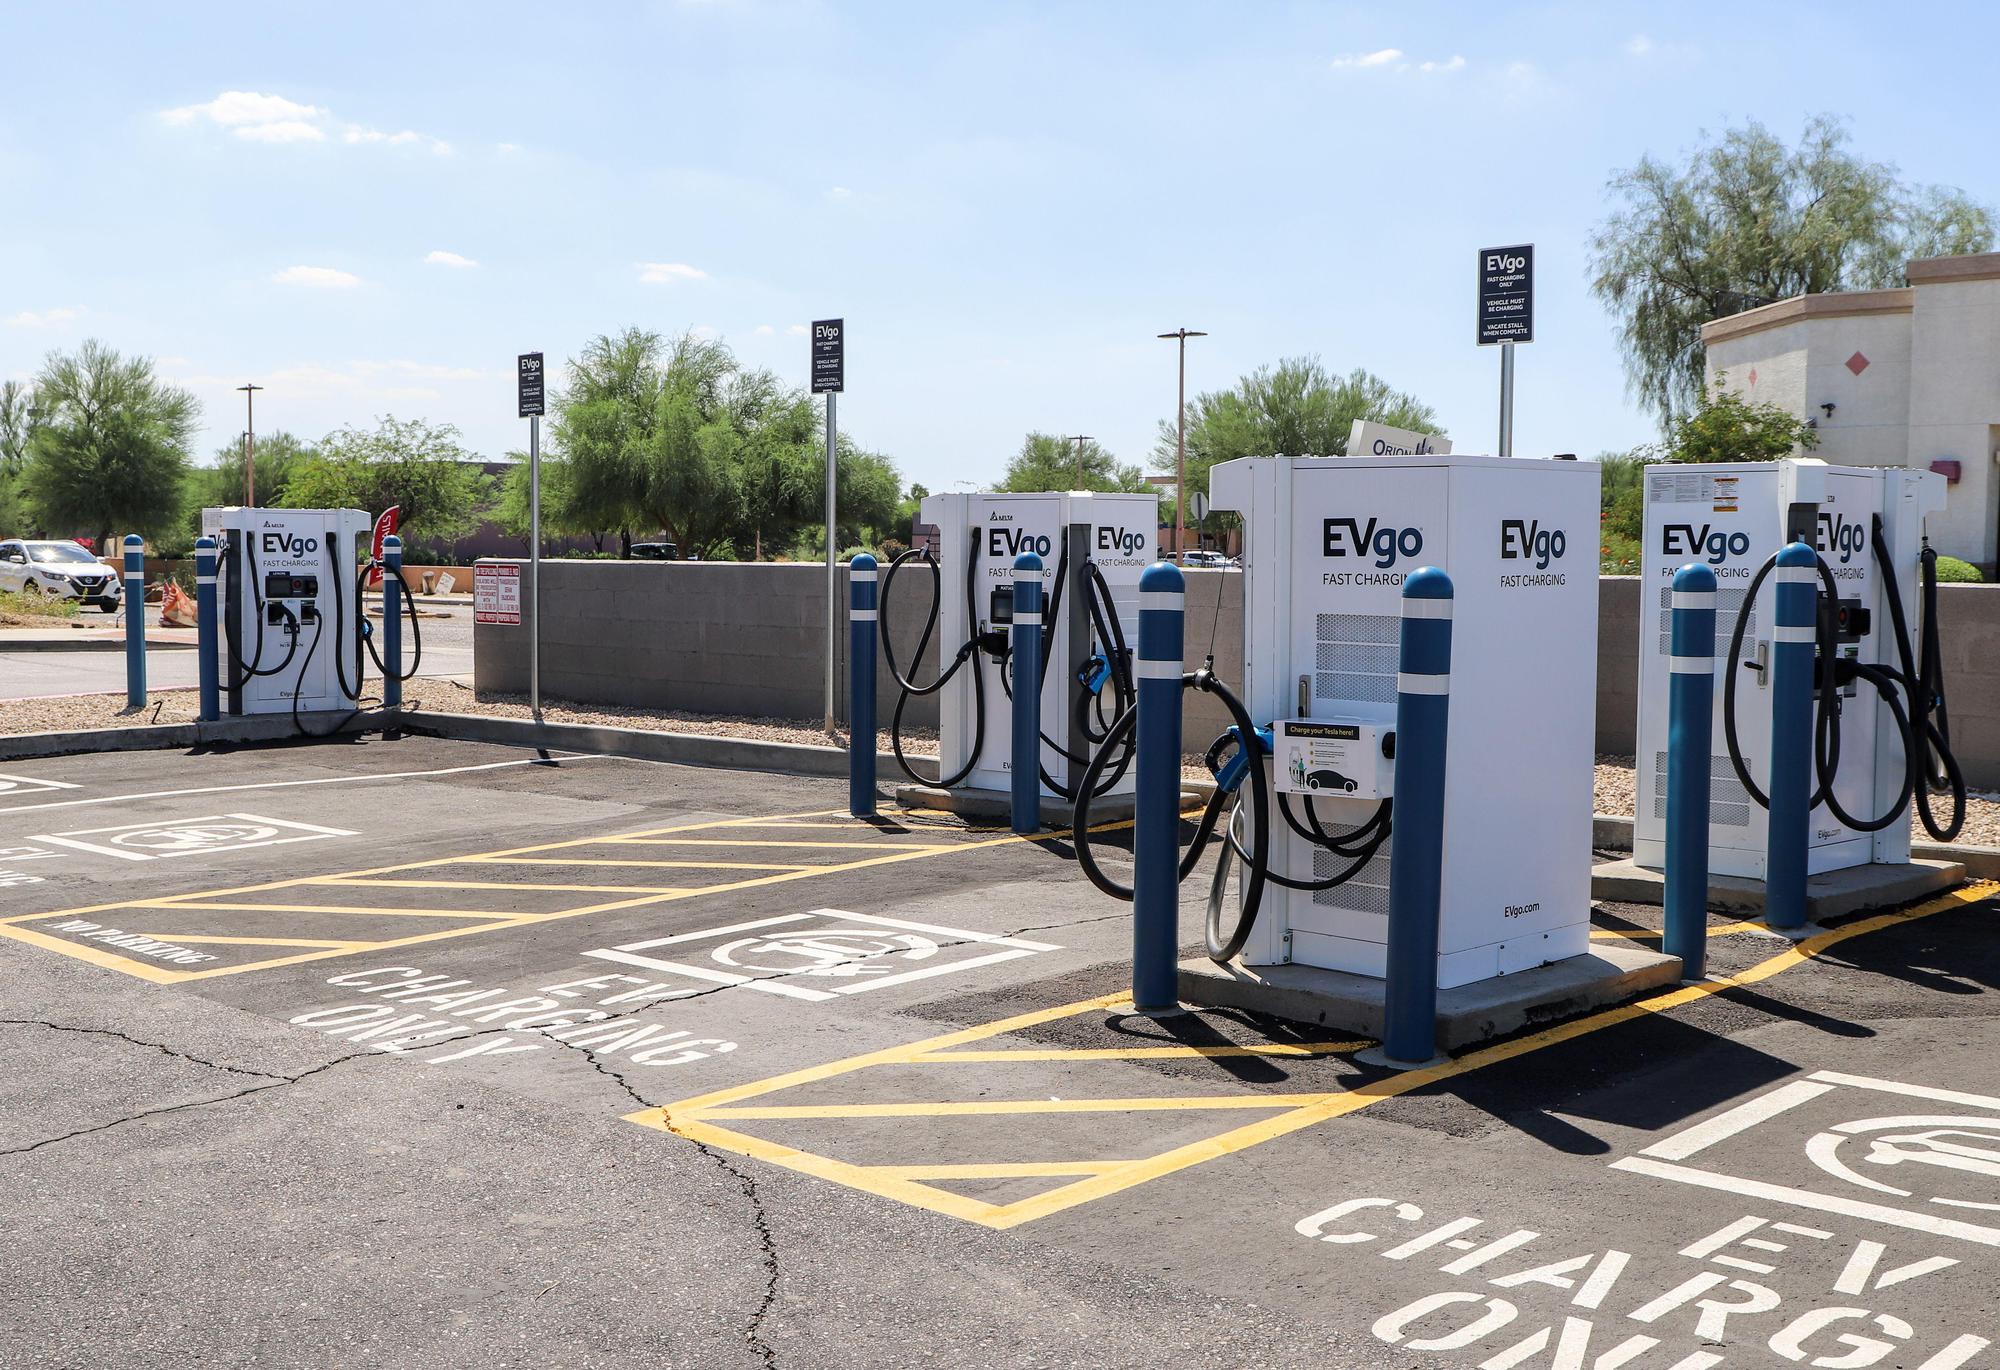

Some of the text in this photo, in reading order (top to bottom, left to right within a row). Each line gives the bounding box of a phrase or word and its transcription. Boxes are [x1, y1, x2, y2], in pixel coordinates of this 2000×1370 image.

[1487, 254, 1525, 273] EVgo
[1499, 274, 1525, 282] CHARGING
[1496, 304, 1523, 312] CHARGING
[816, 325, 839, 340] EVgo
[521, 359, 540, 371] EVgo
[263, 532, 318, 558] EVgo
[989, 527, 1051, 557] EVgo
[1098, 526, 1145, 556] EVgo
[1323, 517, 1424, 568] EVgo
[1501, 519, 1566, 570] EVgo
[1663, 524, 1750, 564] EVgo
[989, 568, 1008, 577] FAST
[1097, 558, 1145, 567] FAST CHARGING
[1661, 567, 1750, 578] FA RGING
[1323, 573, 1409, 586] FAST CHARGI
[1500, 573, 1566, 587] FAST CHARGING
[1290, 725, 1311, 734] Charge
[1311, 728, 1324, 736] your
[1324, 728, 1339, 736] Tesla
[1504, 903, 1540, 918] EVgo.com
[44, 919, 220, 964] NO PARKING
[537, 973, 702, 1006] EV
[326, 966, 739, 1067] CHARGING
[289, 1003, 546, 1065] ONLY
[1678, 1214, 1963, 1296] EV
[1371, 1291, 1726, 1370] ON
